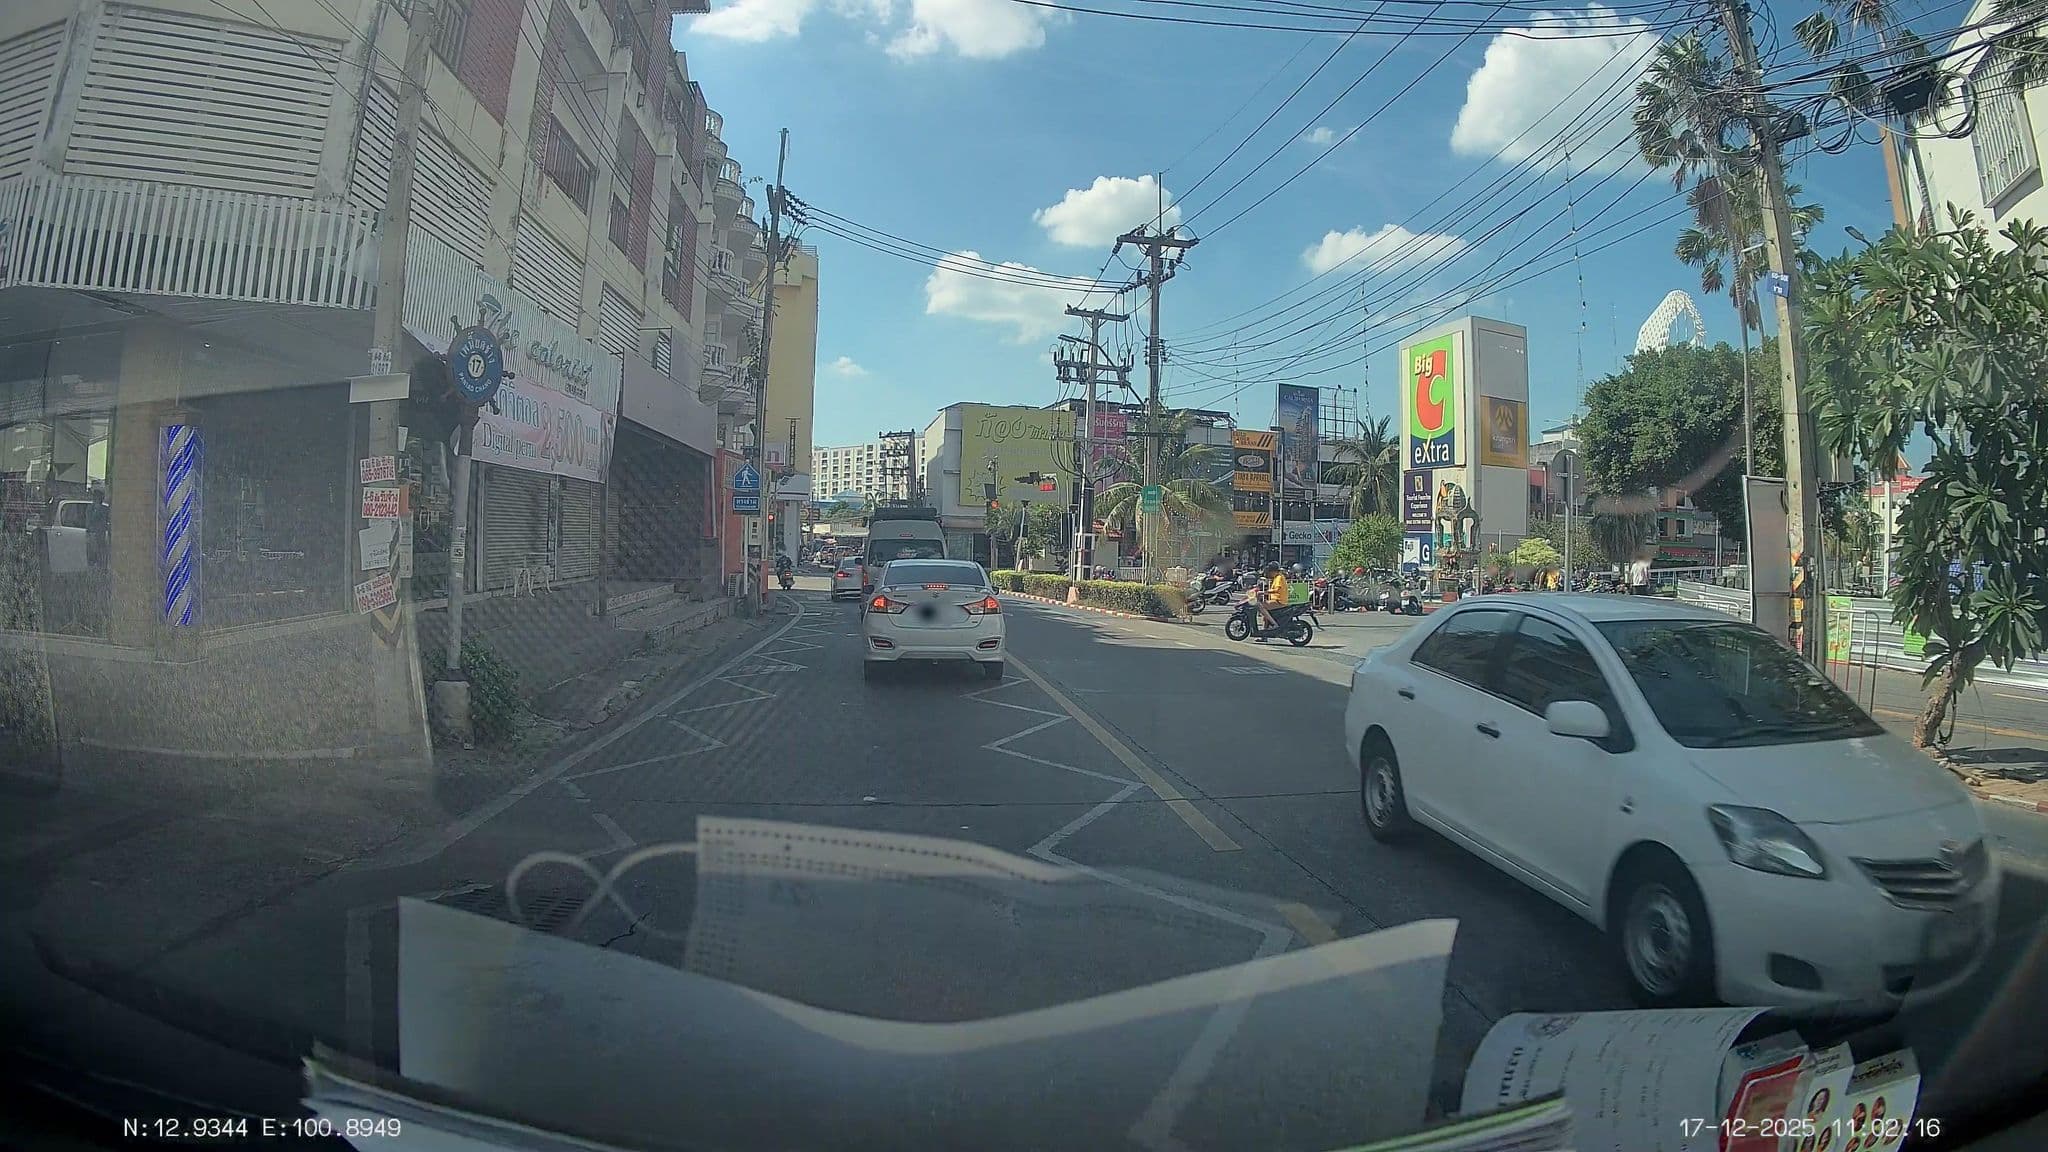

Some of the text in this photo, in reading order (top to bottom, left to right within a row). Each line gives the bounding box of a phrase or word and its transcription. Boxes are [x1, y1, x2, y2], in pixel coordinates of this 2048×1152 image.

[472, 358, 482, 374] 17
[1414, 349, 1448, 432] Big C
[482, 422, 514, 456] Digital
[1288, 531, 1312, 541] Gecko
